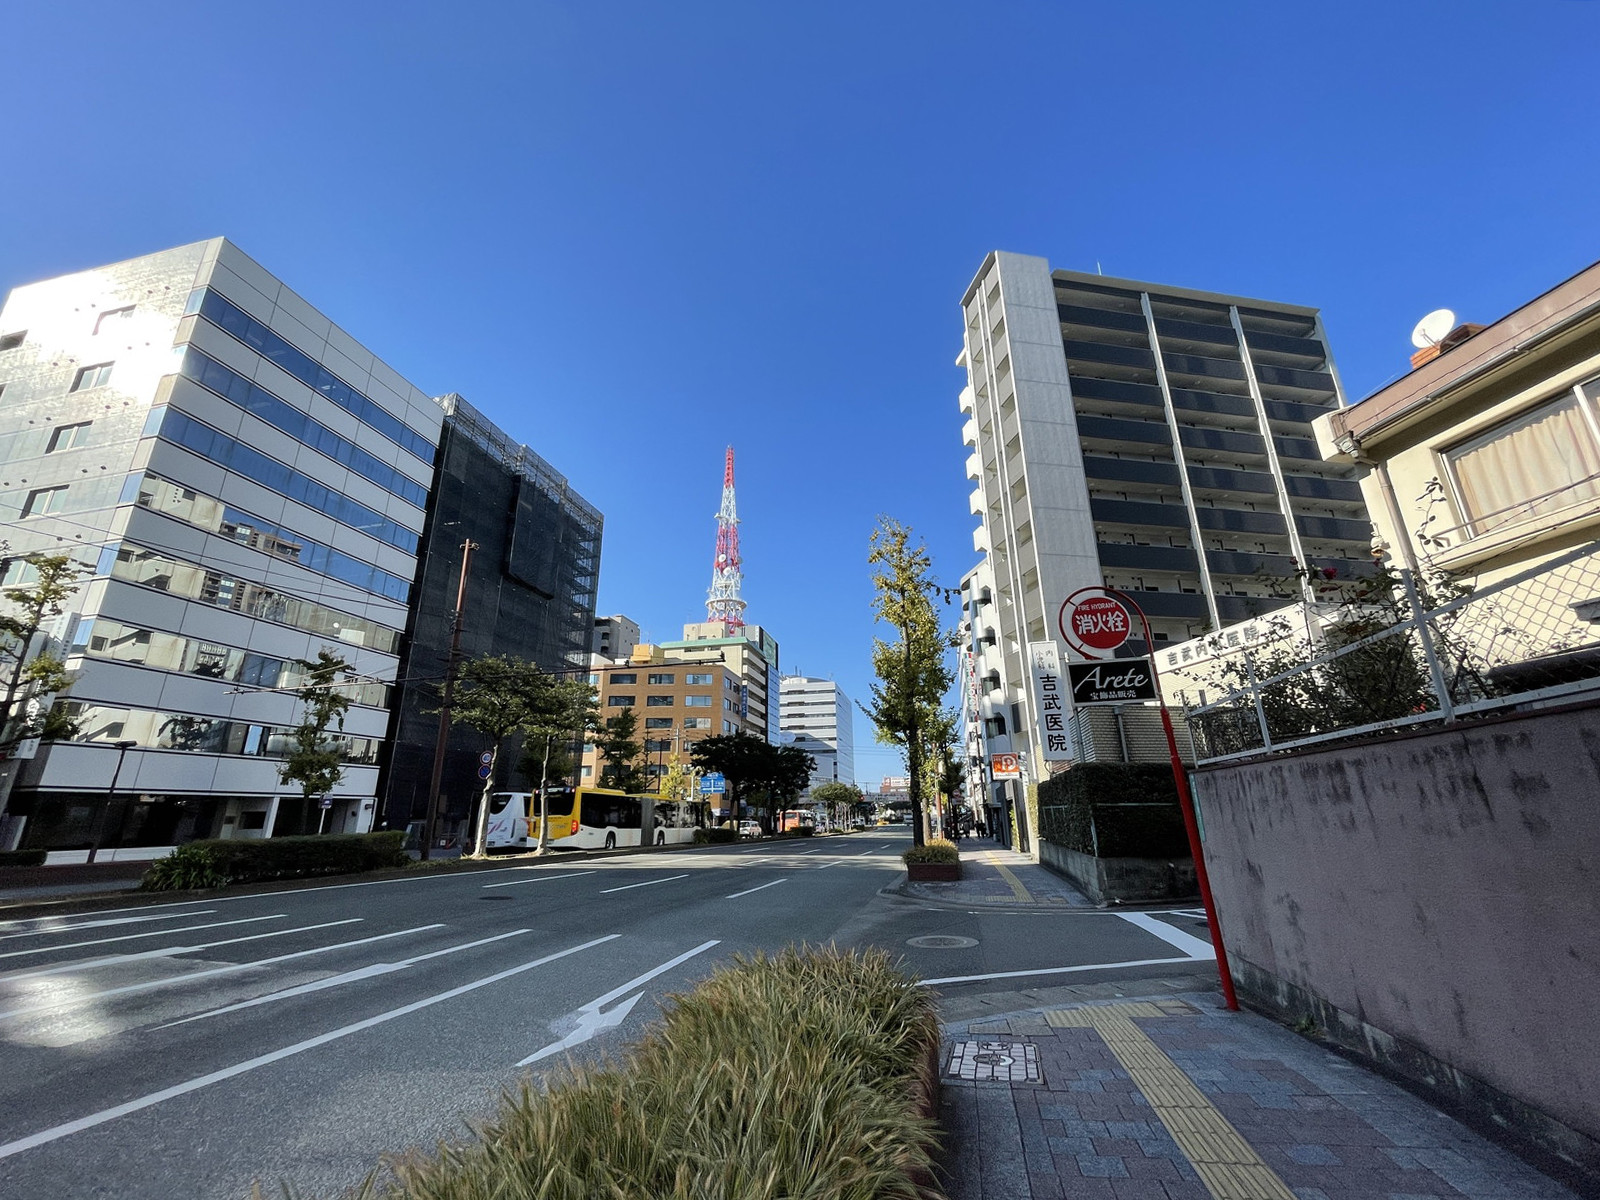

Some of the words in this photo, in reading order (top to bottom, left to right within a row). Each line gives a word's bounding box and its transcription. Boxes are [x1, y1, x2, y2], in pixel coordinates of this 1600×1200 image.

[1091, 602, 1117, 610] HYDRANT
[1075, 610, 1127, 635] 消火栓
[1074, 666, 1149, 694] Arete
[1039, 673, 1068, 752] 吉武医院
